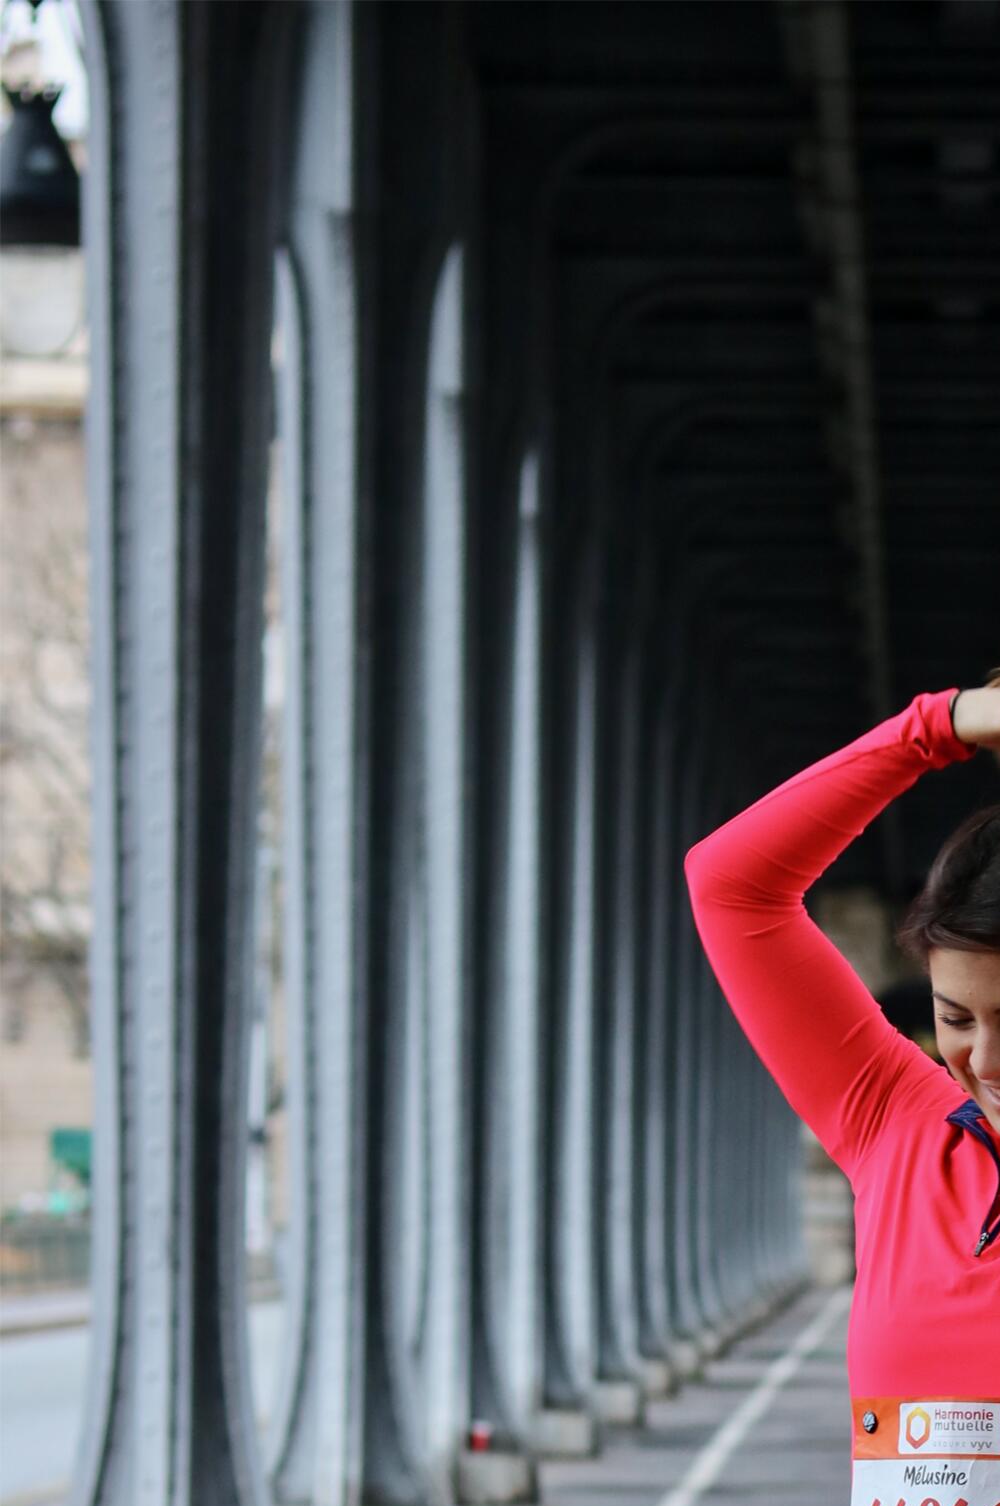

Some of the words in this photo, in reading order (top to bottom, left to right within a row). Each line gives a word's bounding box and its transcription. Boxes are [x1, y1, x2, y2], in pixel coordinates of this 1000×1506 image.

[935, 1408, 994, 1420] Harmonie
[934, 1420, 994, 1431] mutuelle
[904, 1463, 969, 1487] Mélusine
